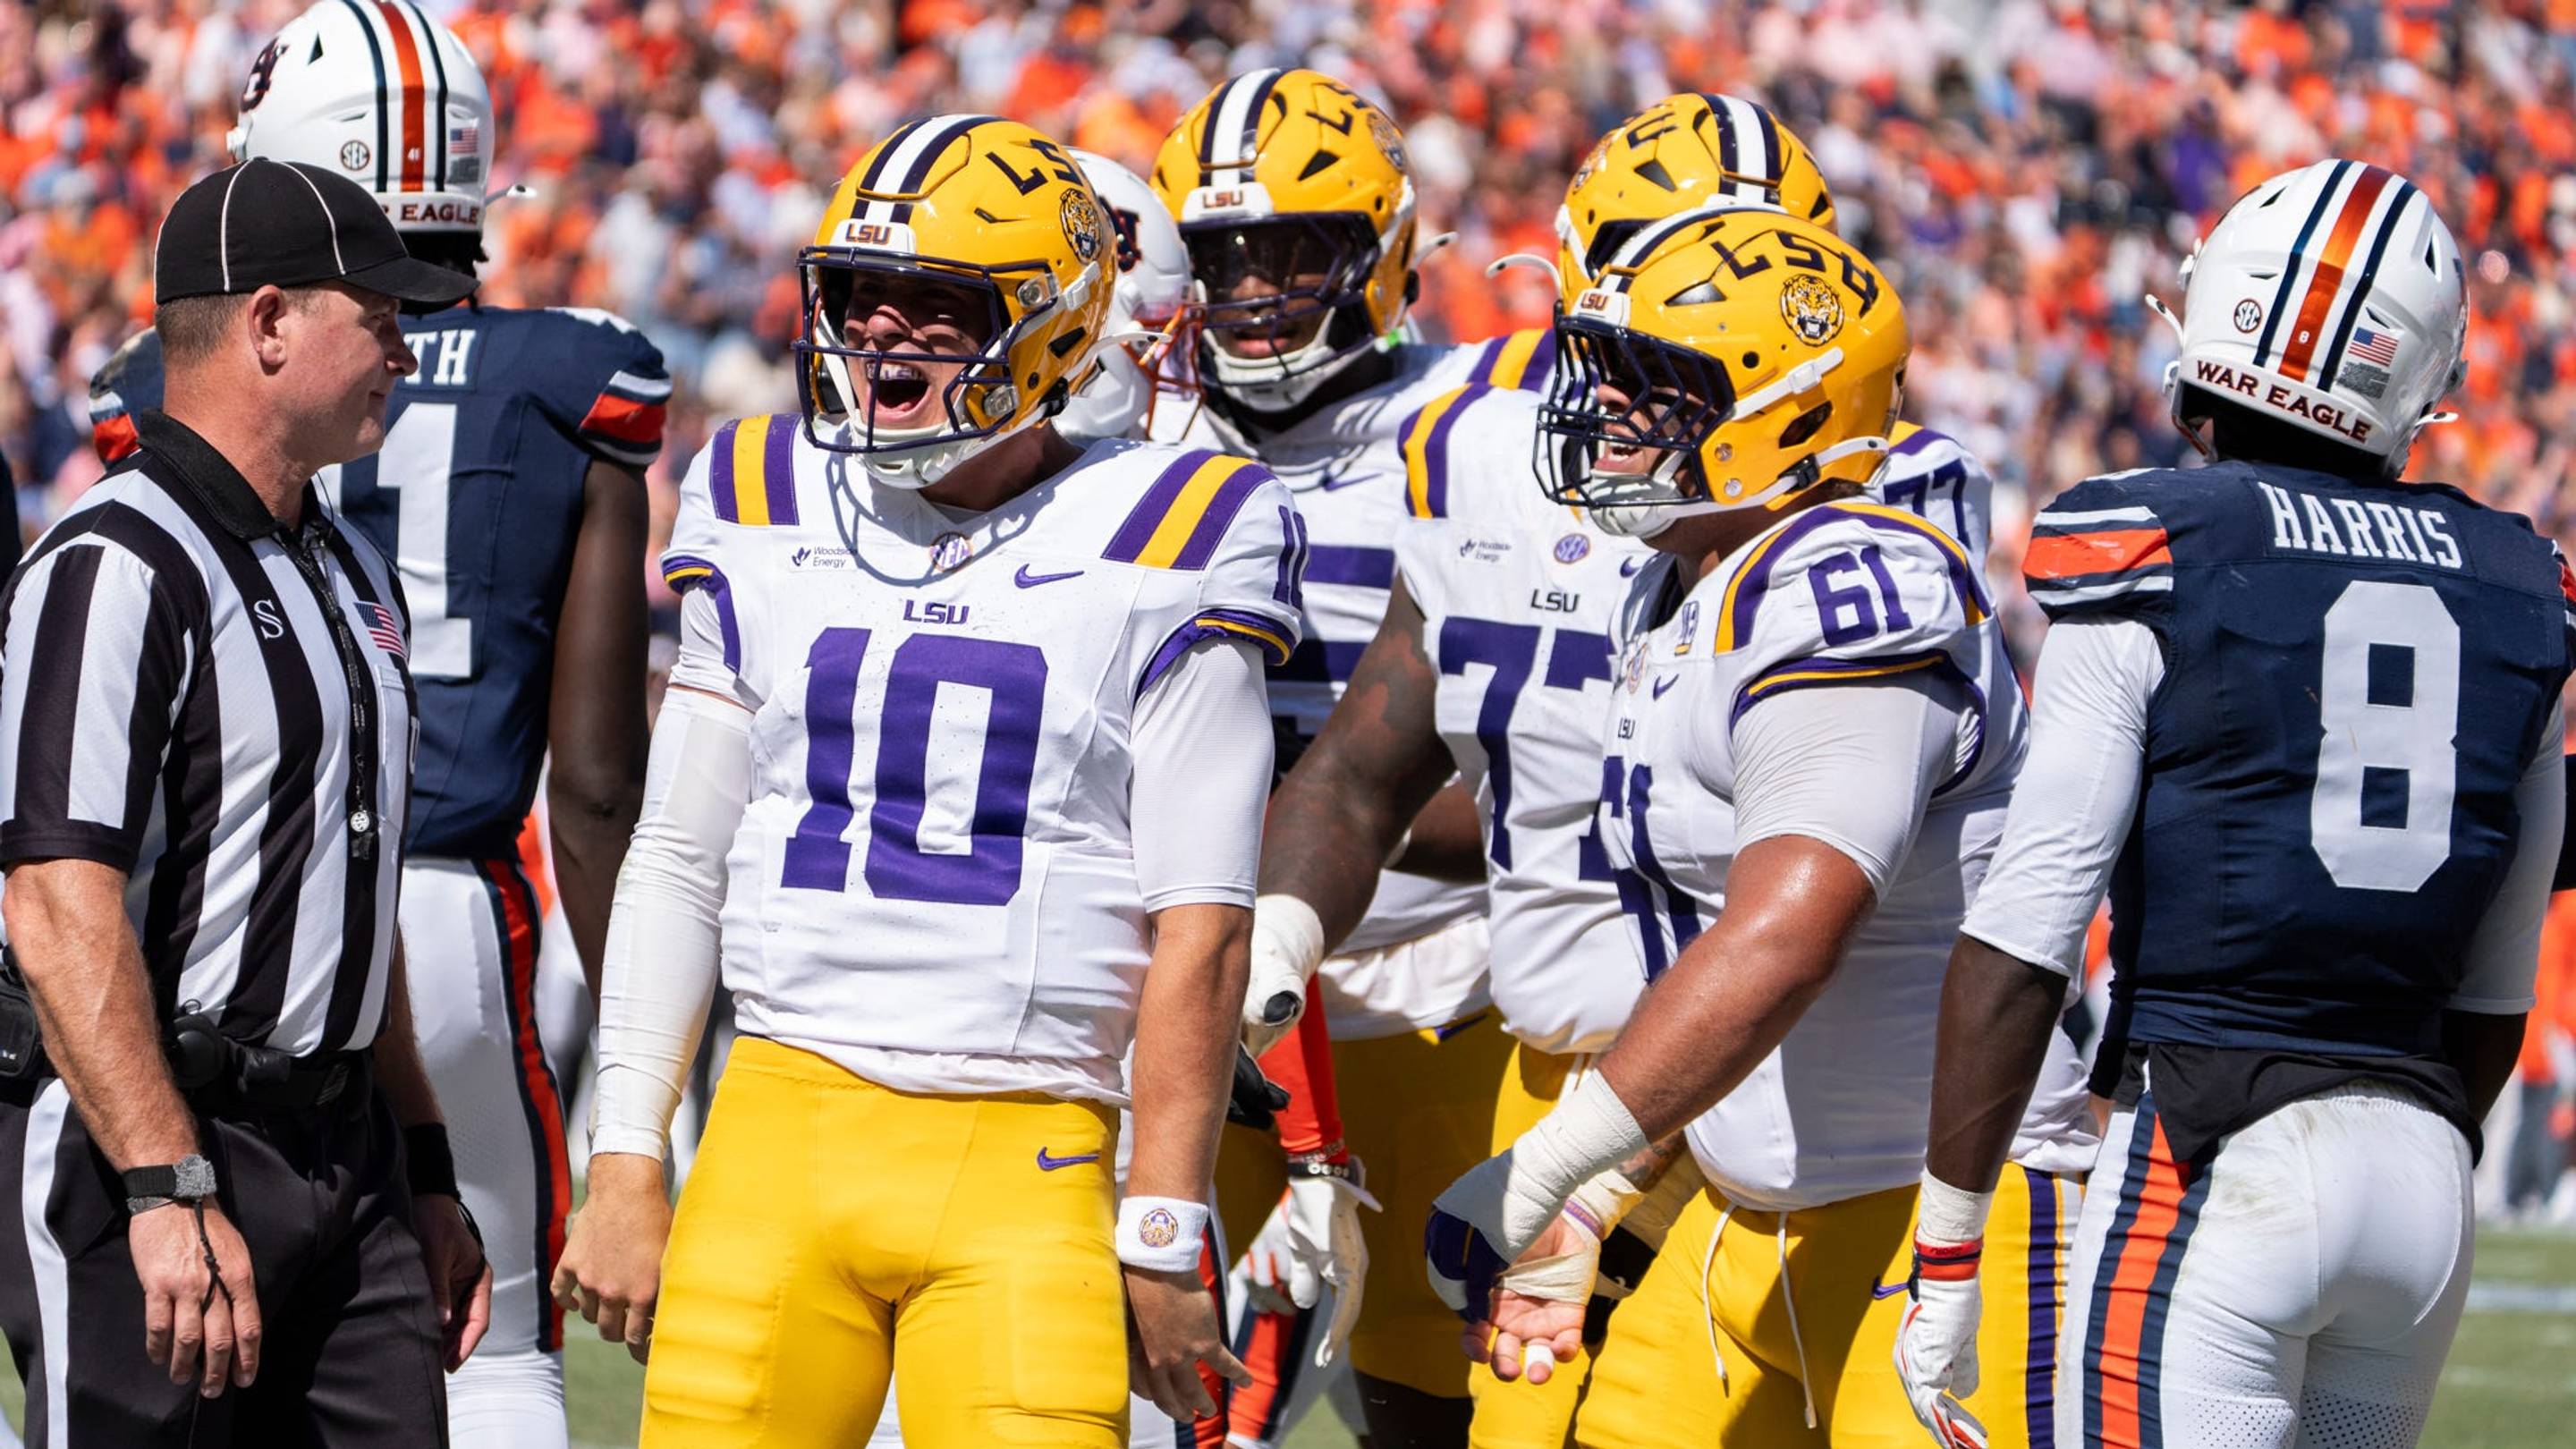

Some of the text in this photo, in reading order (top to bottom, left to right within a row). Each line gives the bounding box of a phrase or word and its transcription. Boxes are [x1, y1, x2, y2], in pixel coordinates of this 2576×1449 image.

[341, 141, 369, 170] SEC
[1203, 190, 1244, 209] LSU
[400, 203, 479, 225] EAGLE
[845, 223, 892, 246] LSU
[1579, 292, 1608, 311] LSU
[2234, 300, 2262, 334] SEC
[2298, 330, 2310, 344] 8
[2197, 360, 2372, 444] WAR EAGLE
[2258, 481, 2462, 570] HARRIS
[814, 546, 857, 555] Woodsi
[1555, 534, 1589, 564] SEC
[813, 556, 846, 568] Energy
[1530, 588, 1580, 613] LSU
[1808, 545, 1913, 648] 61
[254, 598, 284, 640] S
[902, 599, 970, 624] LSU
[1617, 717, 1636, 741] LSU
[2310, 580, 2461, 894] 8
[780, 626, 1049, 907] 10
